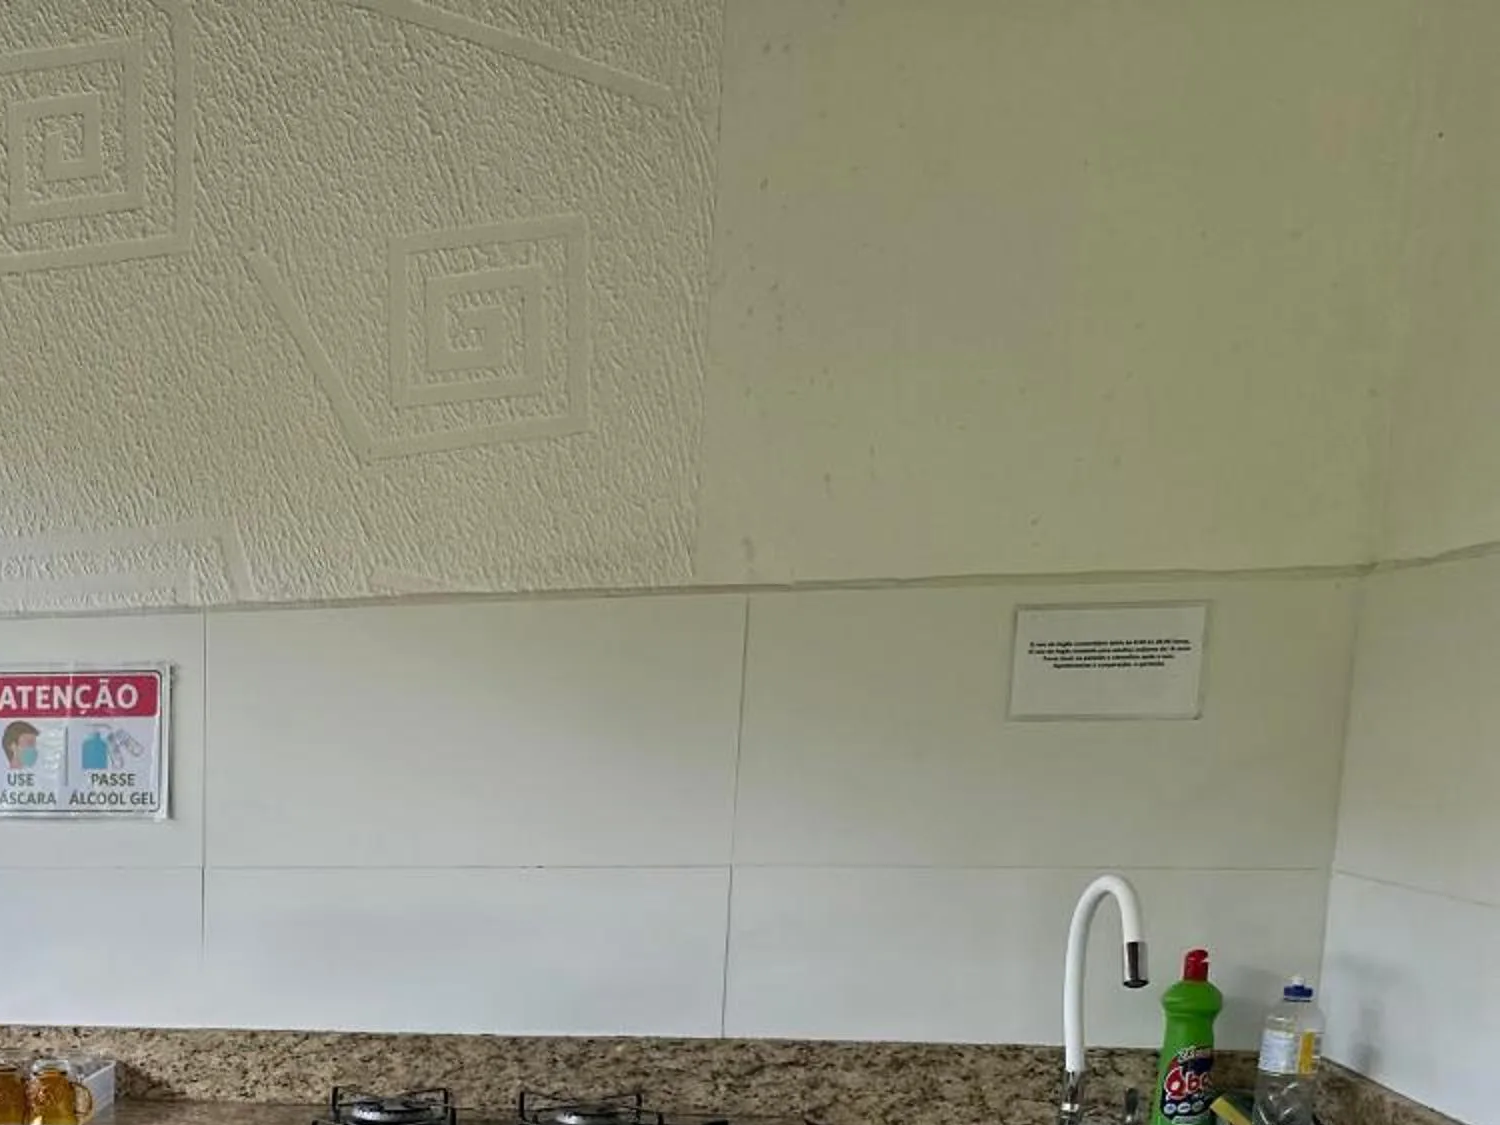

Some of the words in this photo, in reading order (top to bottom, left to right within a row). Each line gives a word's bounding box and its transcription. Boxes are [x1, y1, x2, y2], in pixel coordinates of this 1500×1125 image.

[7, 773, 34, 786] USE
[91, 773, 136, 786] PASSE
[69, 789, 127, 805] ÁLCOOL
[130, 791, 156, 805] GEL
